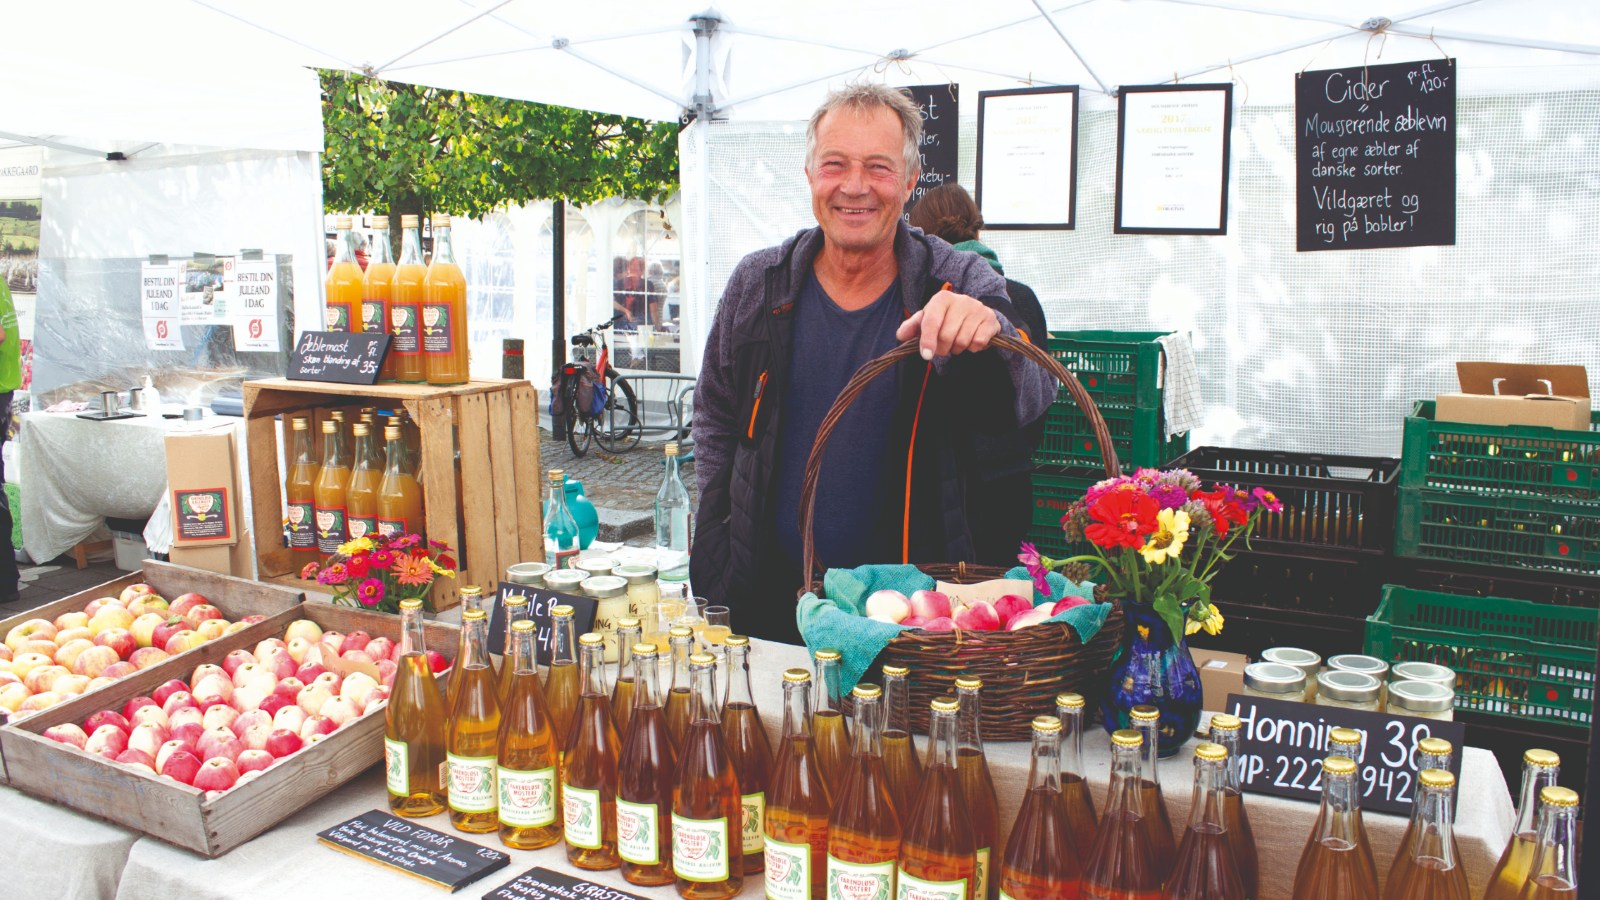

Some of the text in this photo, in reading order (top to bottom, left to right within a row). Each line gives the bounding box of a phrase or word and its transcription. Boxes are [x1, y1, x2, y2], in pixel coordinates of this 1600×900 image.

[1325, 63, 1436, 103] Cider pr. fl.
[1305, 104, 1447, 139] Mousserende æblevin
[1312, 138, 1421, 164] af egne æbler af
[1312, 161, 1356, 177] danske
[1312, 185, 1419, 217] Vildgæret og
[1315, 218, 1335, 243] rig
[1343, 216, 1359, 242] på
[144, 277, 175, 286] BESTIL DIN
[237, 272, 274, 282] BESTIL DIN
[146, 290, 173, 299] JULEAND
[239, 285, 270, 296] JULEAND
[154, 301, 169, 311] DAG
[248, 298, 265, 308] DAG
[323, 354, 351, 369] blanding
[501, 588, 543, 617] Mile
[382, 818, 411, 833] VILD
[410, 828, 455, 849] FORÅR
